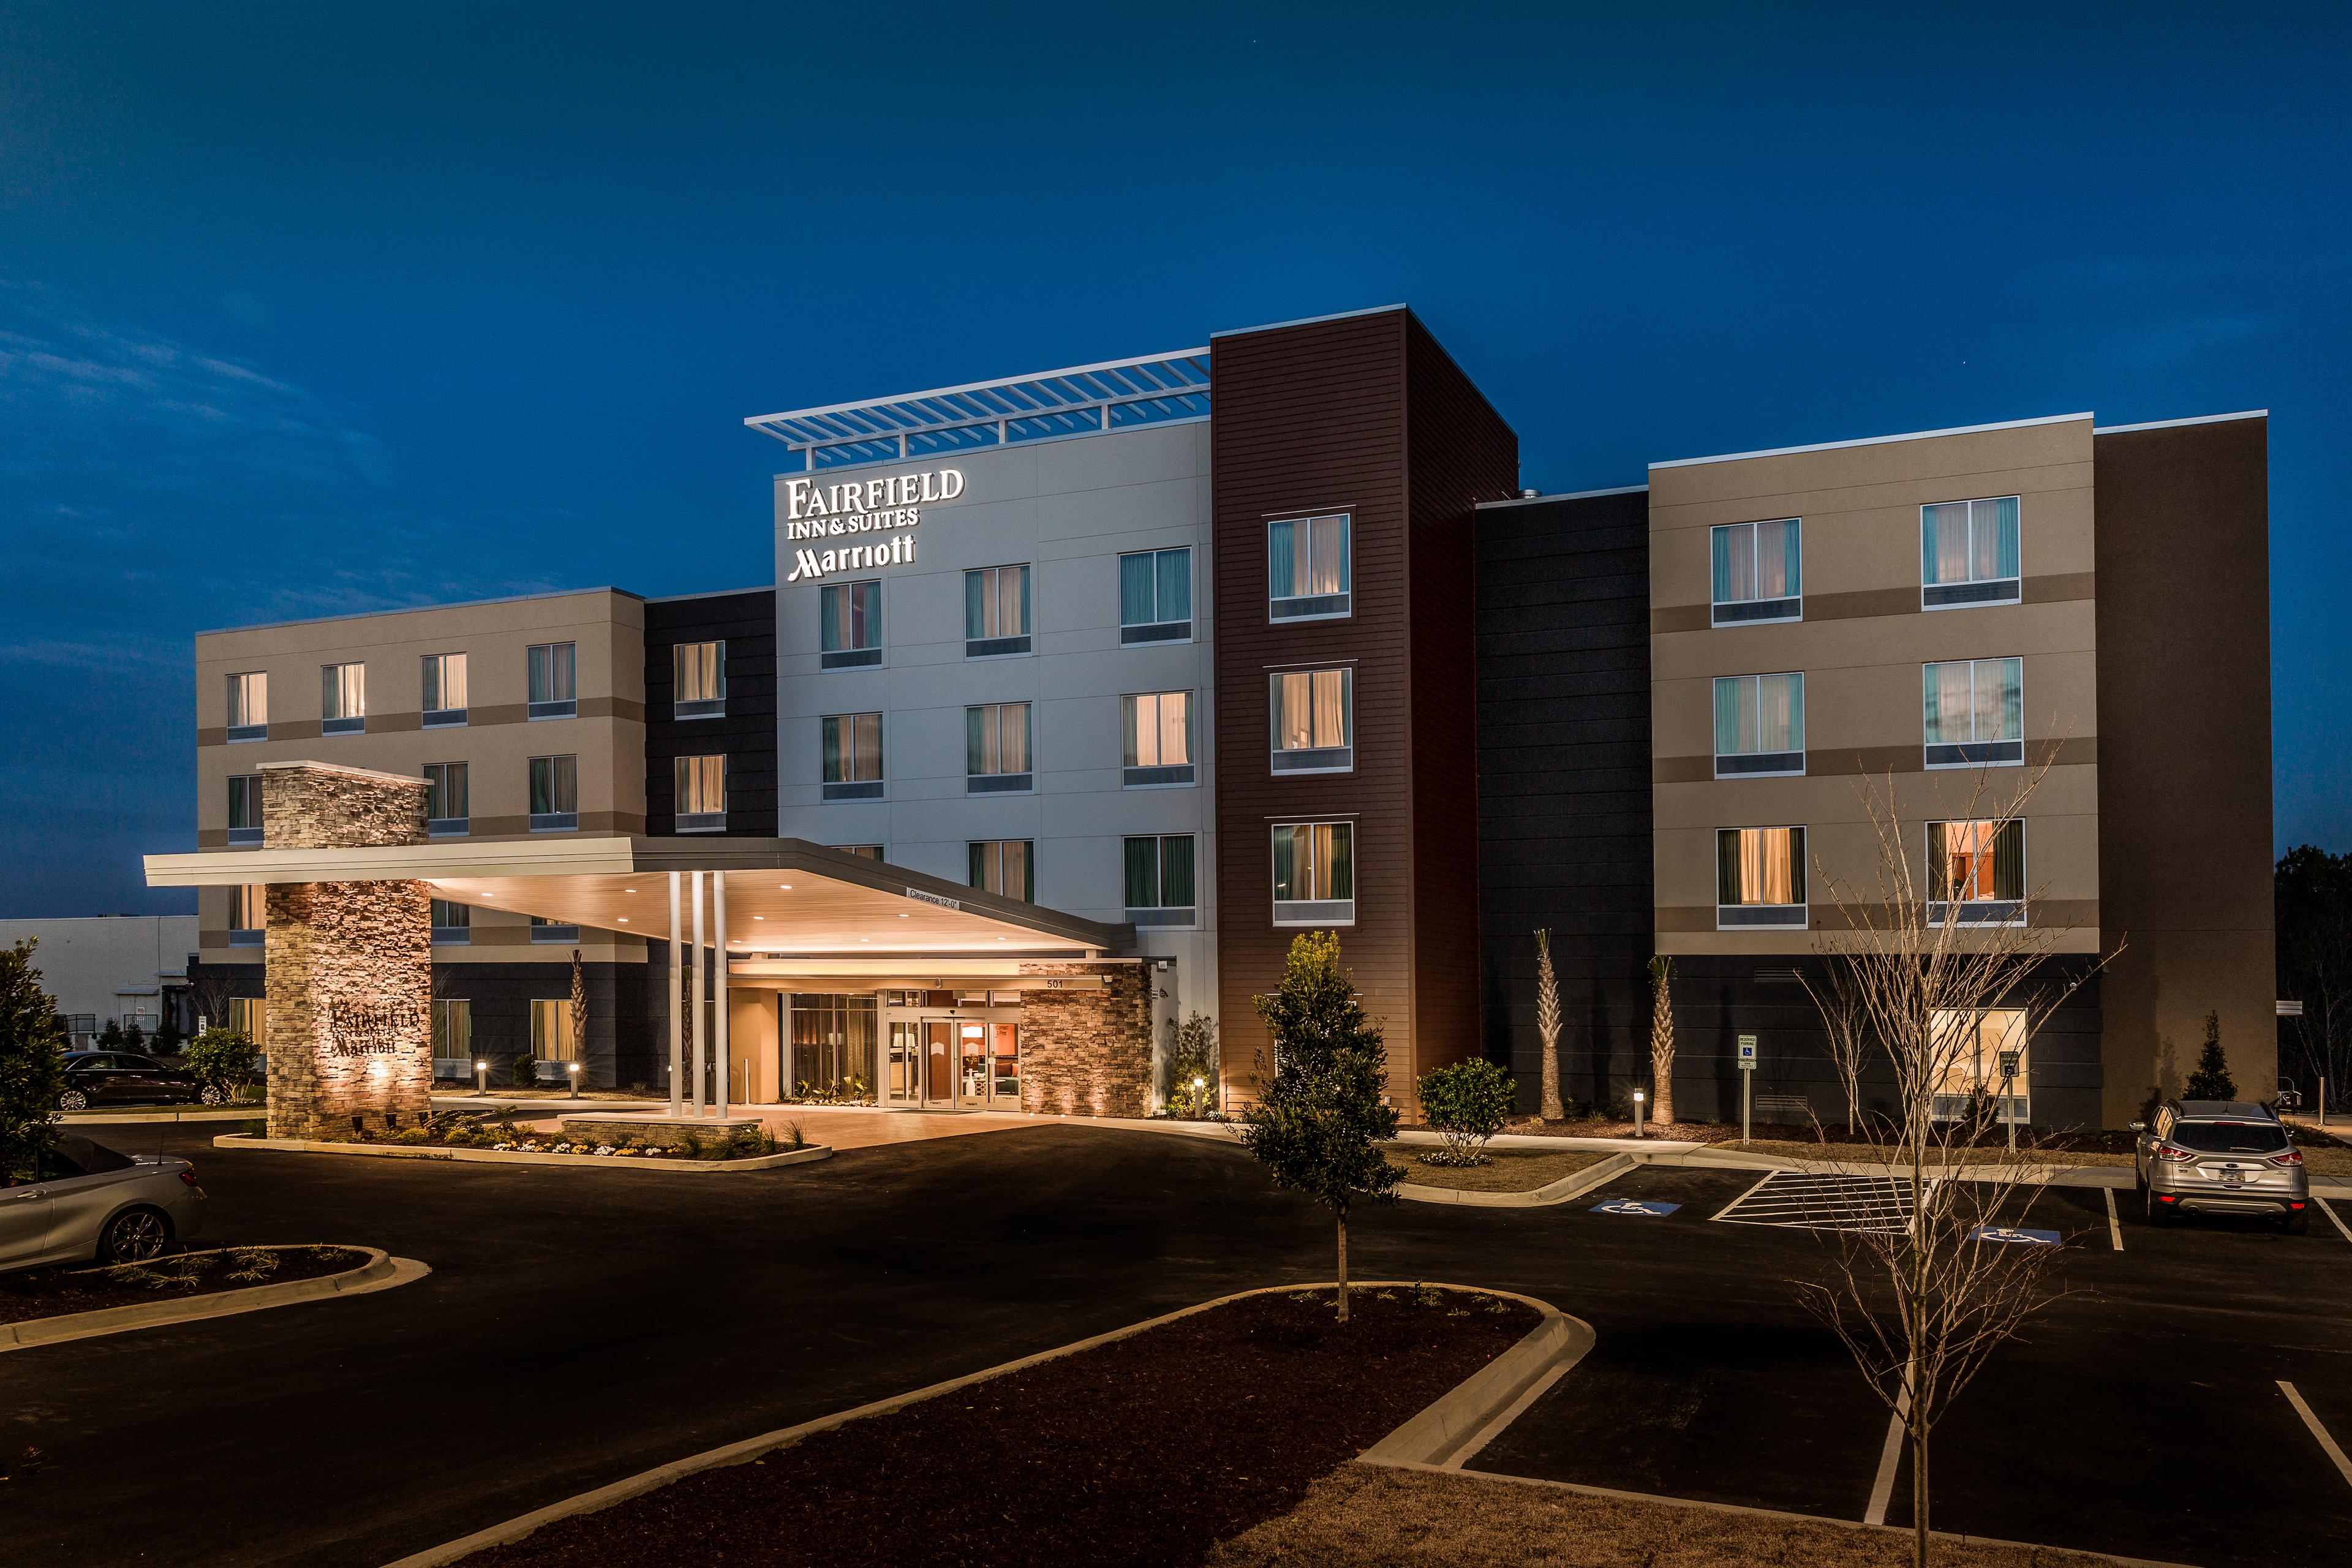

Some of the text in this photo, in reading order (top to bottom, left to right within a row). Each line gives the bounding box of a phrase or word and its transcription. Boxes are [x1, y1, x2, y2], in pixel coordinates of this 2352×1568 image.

[786, 469, 966, 520] FAIRFIELD
[787, 534, 916, 582] Marriott
[910, 890, 957, 908] Clearance 12'-0"
[333, 1011, 420, 1028] FAIRFIELD
[333, 1036, 397, 1057] Marriott
